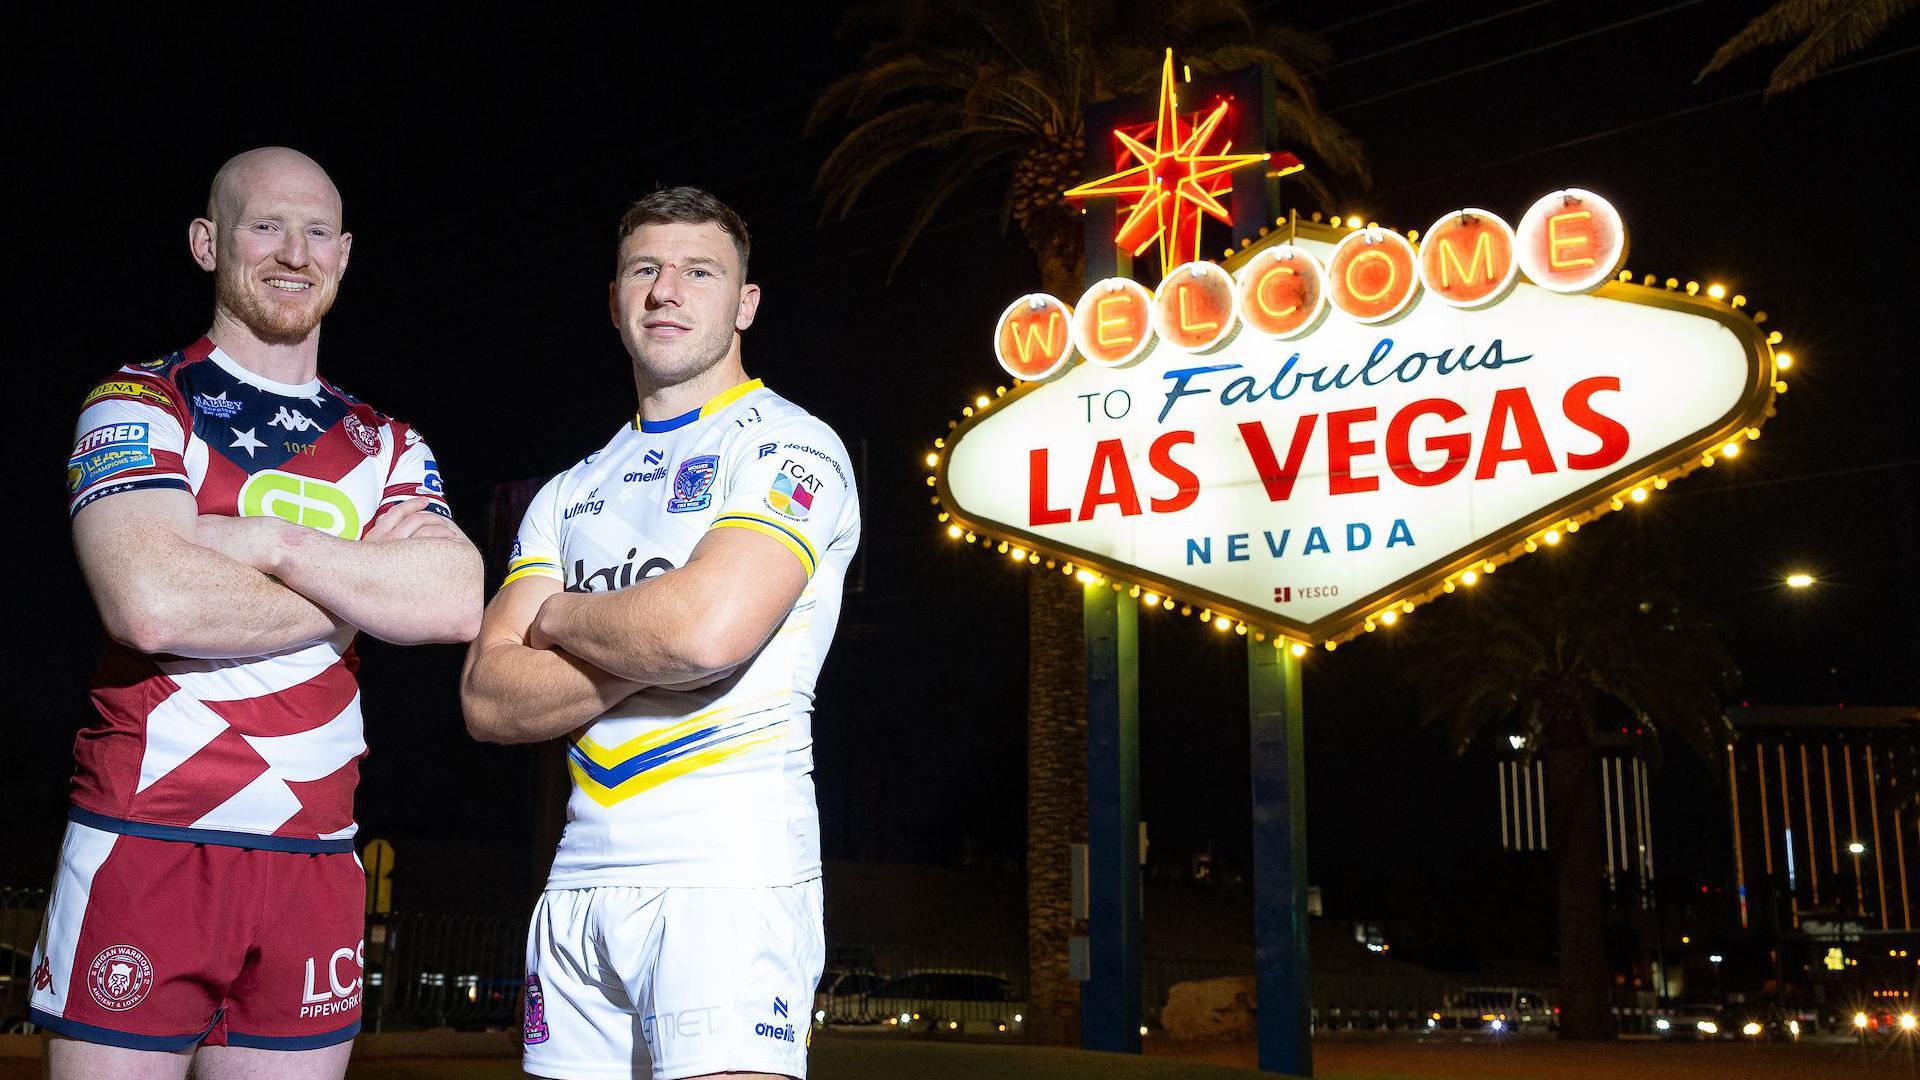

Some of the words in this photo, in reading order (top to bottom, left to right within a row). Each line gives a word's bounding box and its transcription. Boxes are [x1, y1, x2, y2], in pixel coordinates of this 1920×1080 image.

[1011, 210, 1595, 364] WELCOME
[1078, 389, 1131, 424] TO
[1157, 337, 1534, 424] Fabulous
[73, 424, 146, 455] ETFRED
[283, 441, 317, 457] 1017
[1028, 429, 1201, 527] LAS
[1237, 376, 1631, 502] VEGAS
[89, 458, 129, 478] CHAMPIONS
[1185, 519, 1416, 566] NEVADA
[1298, 585, 1339, 599] YESCO
[93, 948, 117, 969] WIGAN
[118, 947, 151, 977] WARRIORS
[92, 987, 115, 1007] ANCIENT
[123, 994, 142, 1007] LOYAL
